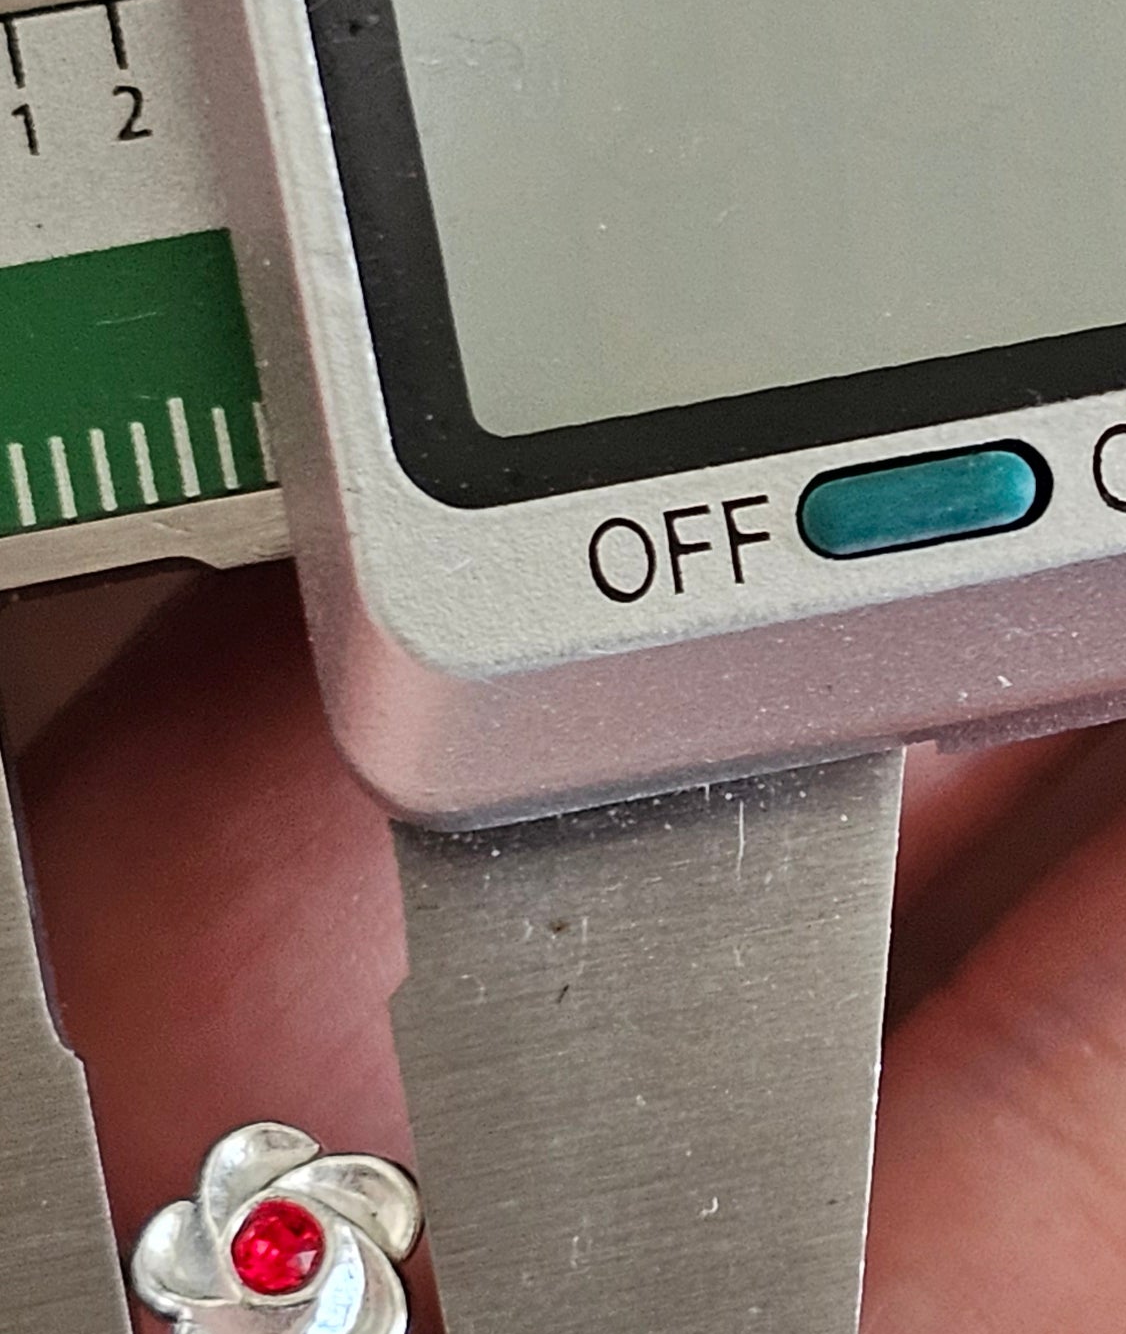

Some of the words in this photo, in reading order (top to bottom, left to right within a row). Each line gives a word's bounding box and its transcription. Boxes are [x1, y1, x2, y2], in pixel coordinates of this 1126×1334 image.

[12, 103, 40, 156] 1
[113, 85, 154, 142] 2
[588, 495, 773, 604] OFF
